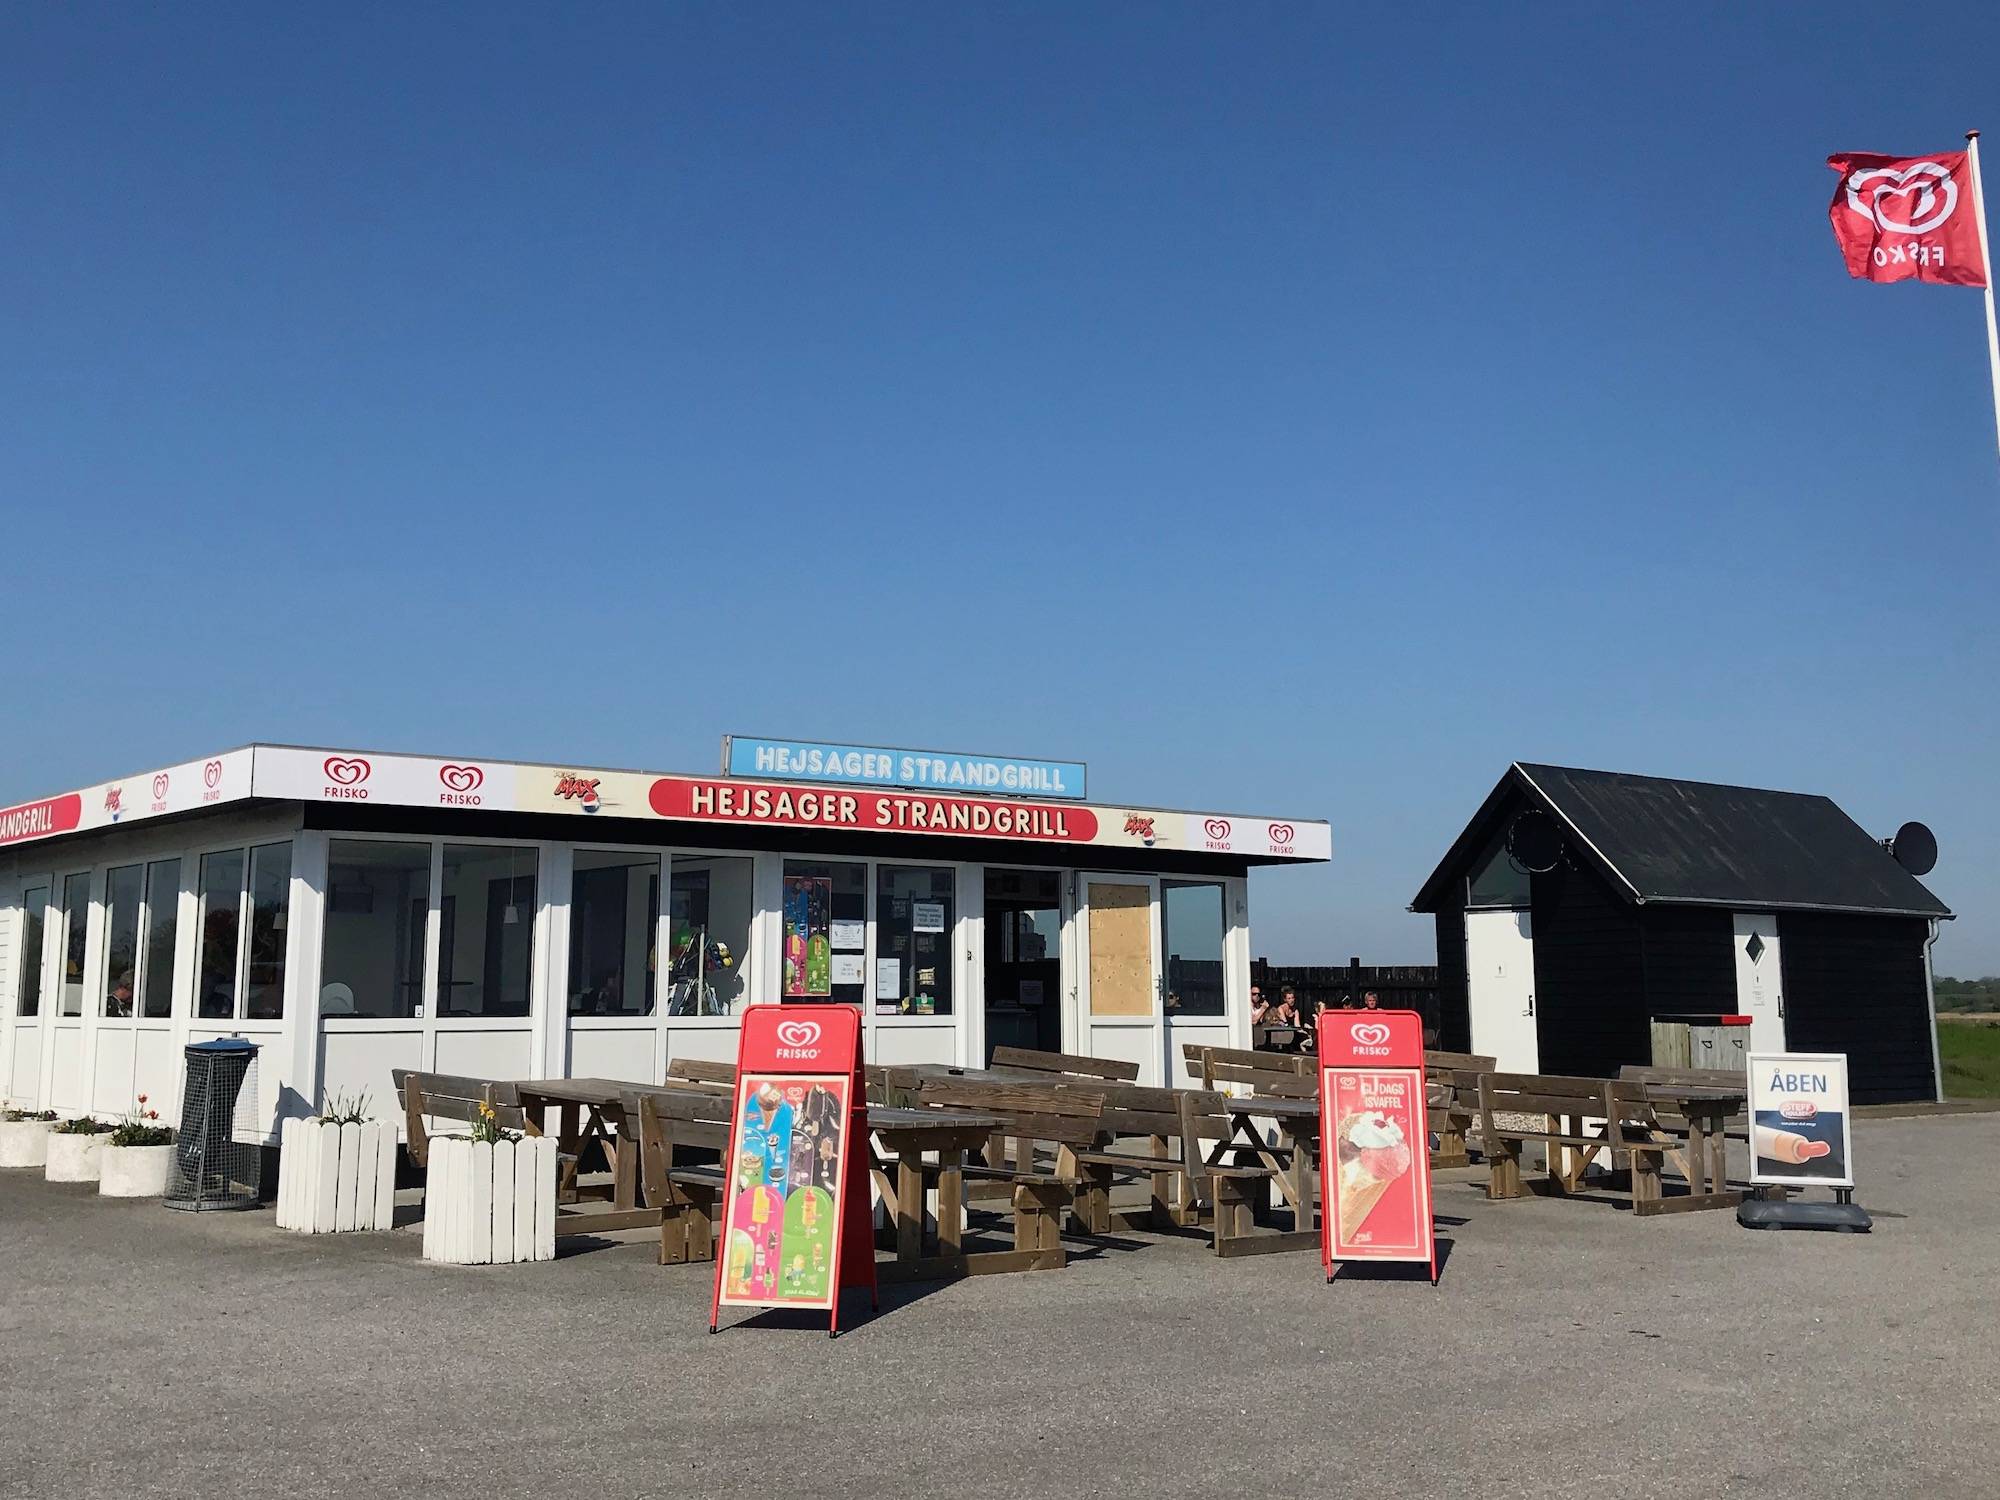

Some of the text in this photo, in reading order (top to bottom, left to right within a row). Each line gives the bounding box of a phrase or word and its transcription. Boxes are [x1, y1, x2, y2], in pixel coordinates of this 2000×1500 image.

[755, 745, 1066, 792] HEJSAGER STRANDGRILL
[324, 786, 369, 799] FRISKO
[554, 777, 600, 800] MAX
[203, 790, 220, 802] FRISKO
[440, 793, 482, 806] FRISKO
[151, 801, 167, 812] FRISKO
[692, 785, 1070, 837] HEJSAGER STRANDGRILL
[0, 804, 53, 840] ANDGRILL
[1205, 840, 1231, 851] FRISKO
[1269, 845, 1294, 855] FRISKO
[775, 1048, 819, 1060] FRISKO
[1352, 1046, 1390, 1056] FRISKO
[1770, 1067, 1827, 1093] ÅBEN
[1379, 1083, 1406, 1096] DAGS
[1365, 1096, 1404, 1109] ISVAFFEL
